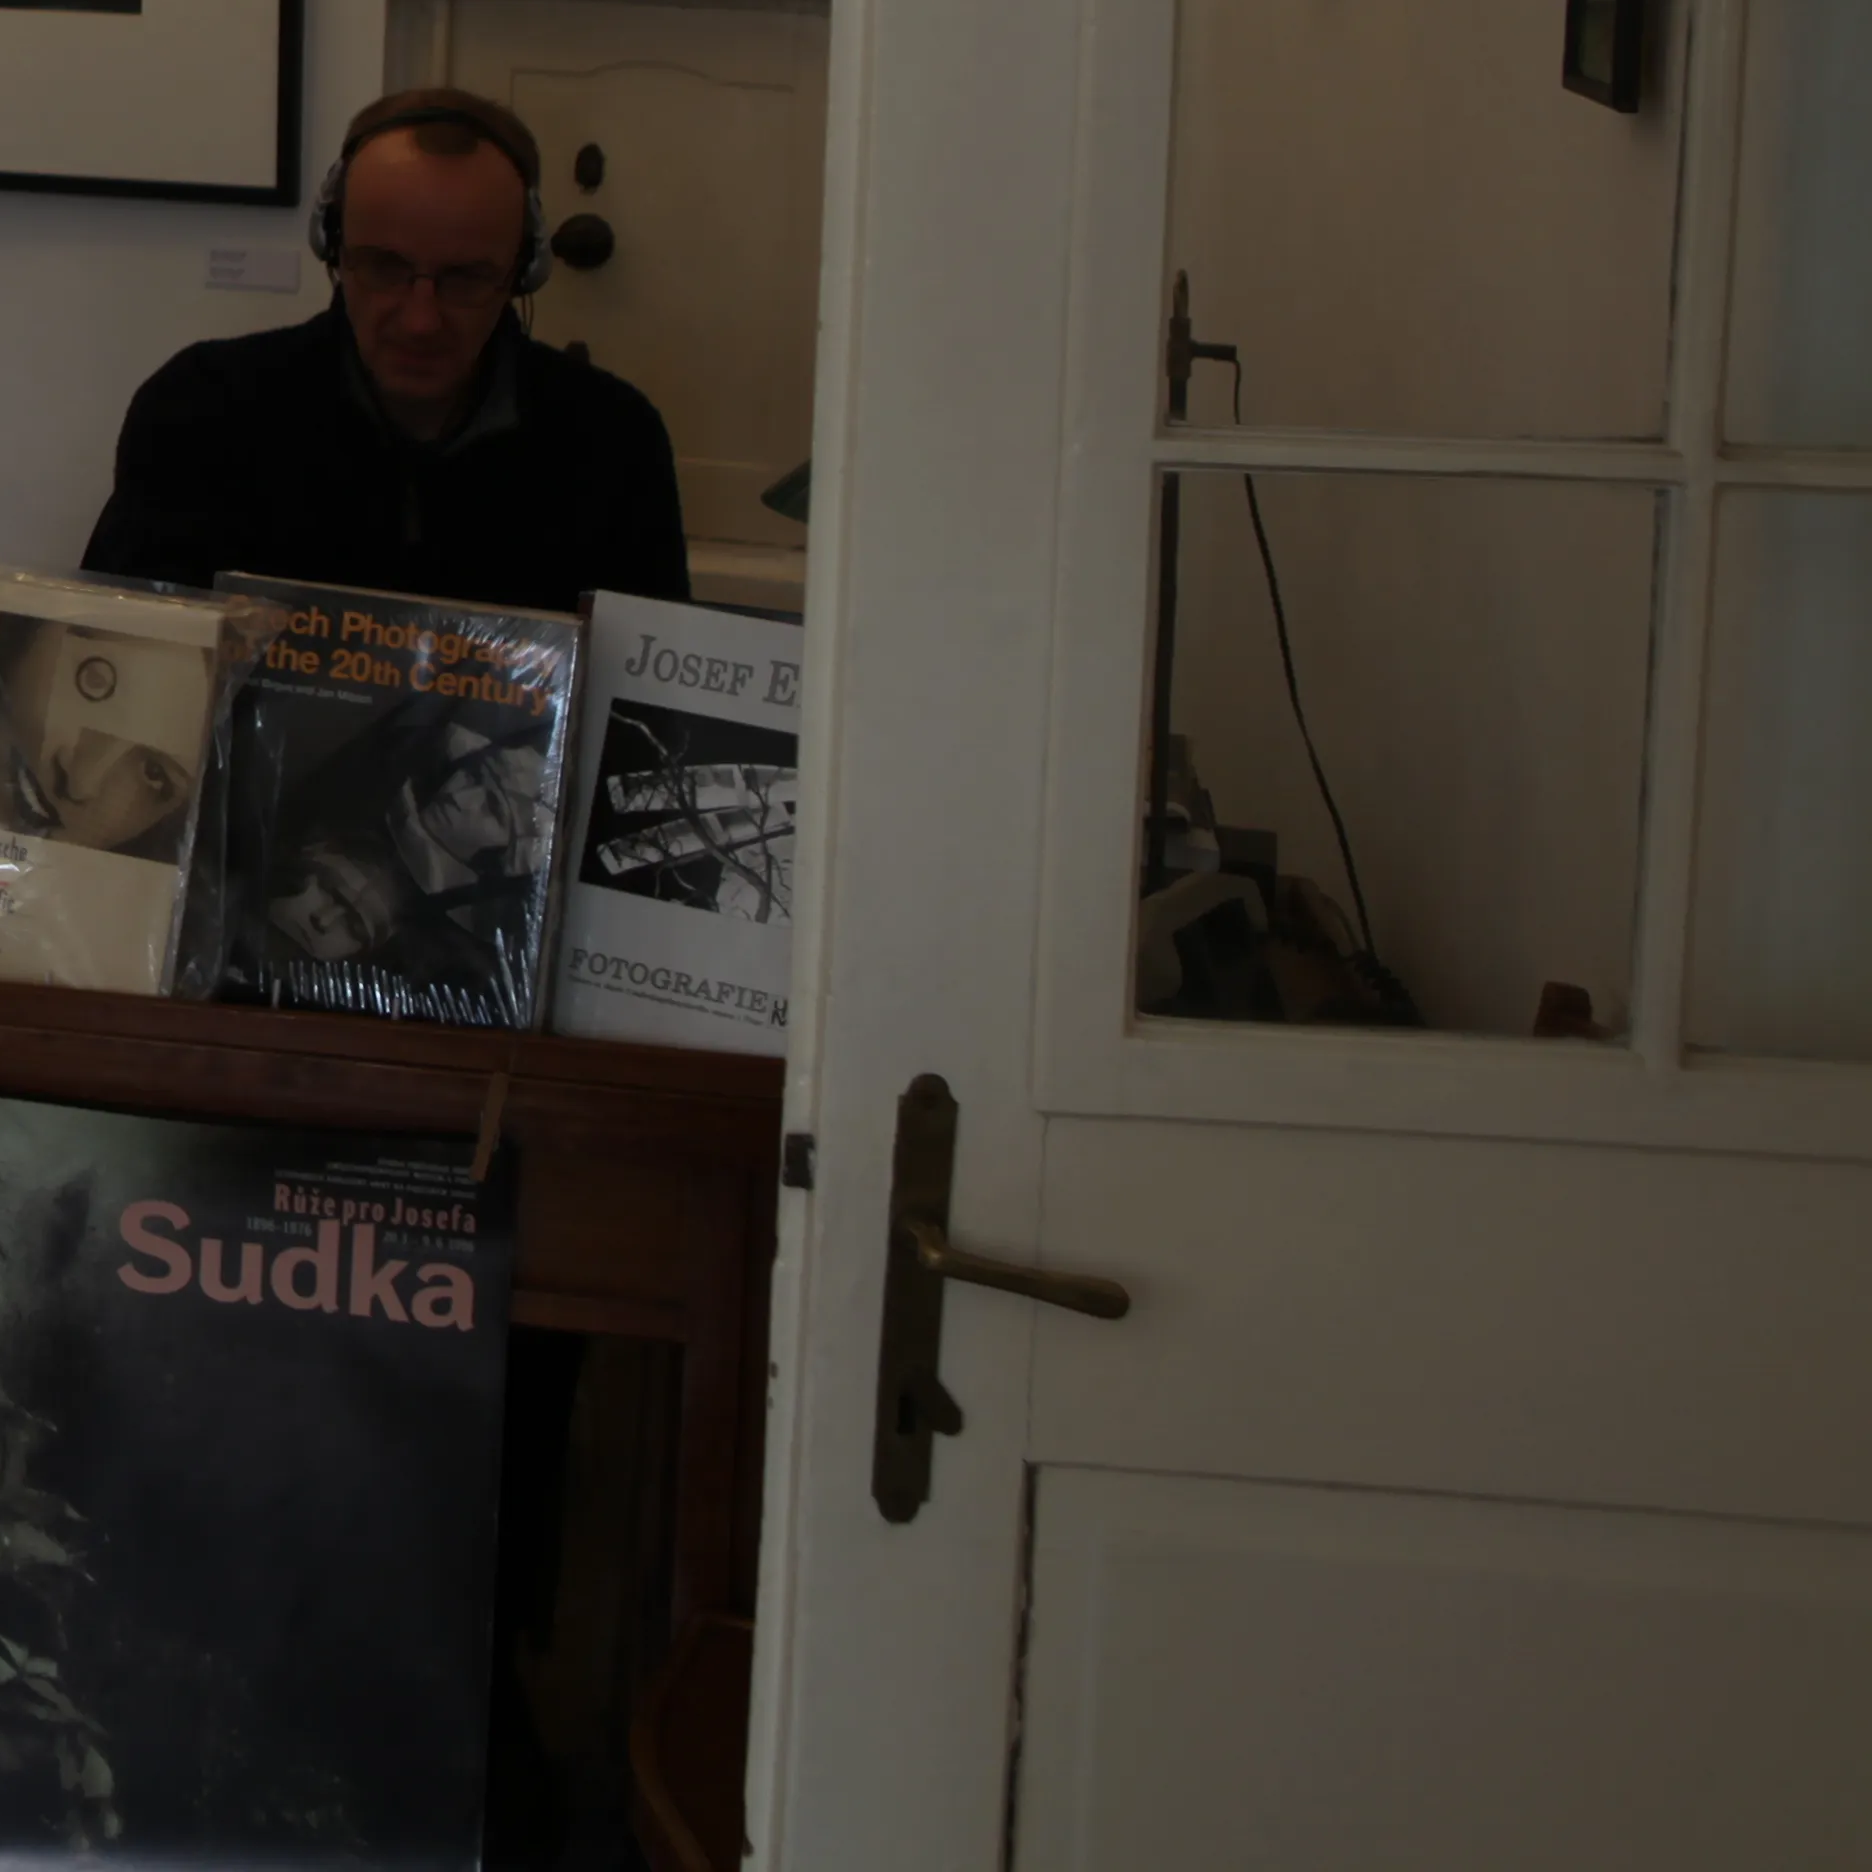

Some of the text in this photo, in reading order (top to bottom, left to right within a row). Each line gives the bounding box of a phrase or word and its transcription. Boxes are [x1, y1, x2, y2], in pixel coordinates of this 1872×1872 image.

[265, 639, 321, 674] the
[328, 647, 402, 688] 20th
[409, 661, 548, 717] Century
[568, 948, 768, 1014] FOTOGRAFIE
[274, 1183, 337, 1216] Růže
[342, 1199, 386, 1226] pro
[390, 1197, 476, 1234] Josefa
[116, 1199, 476, 1332] Sudka
